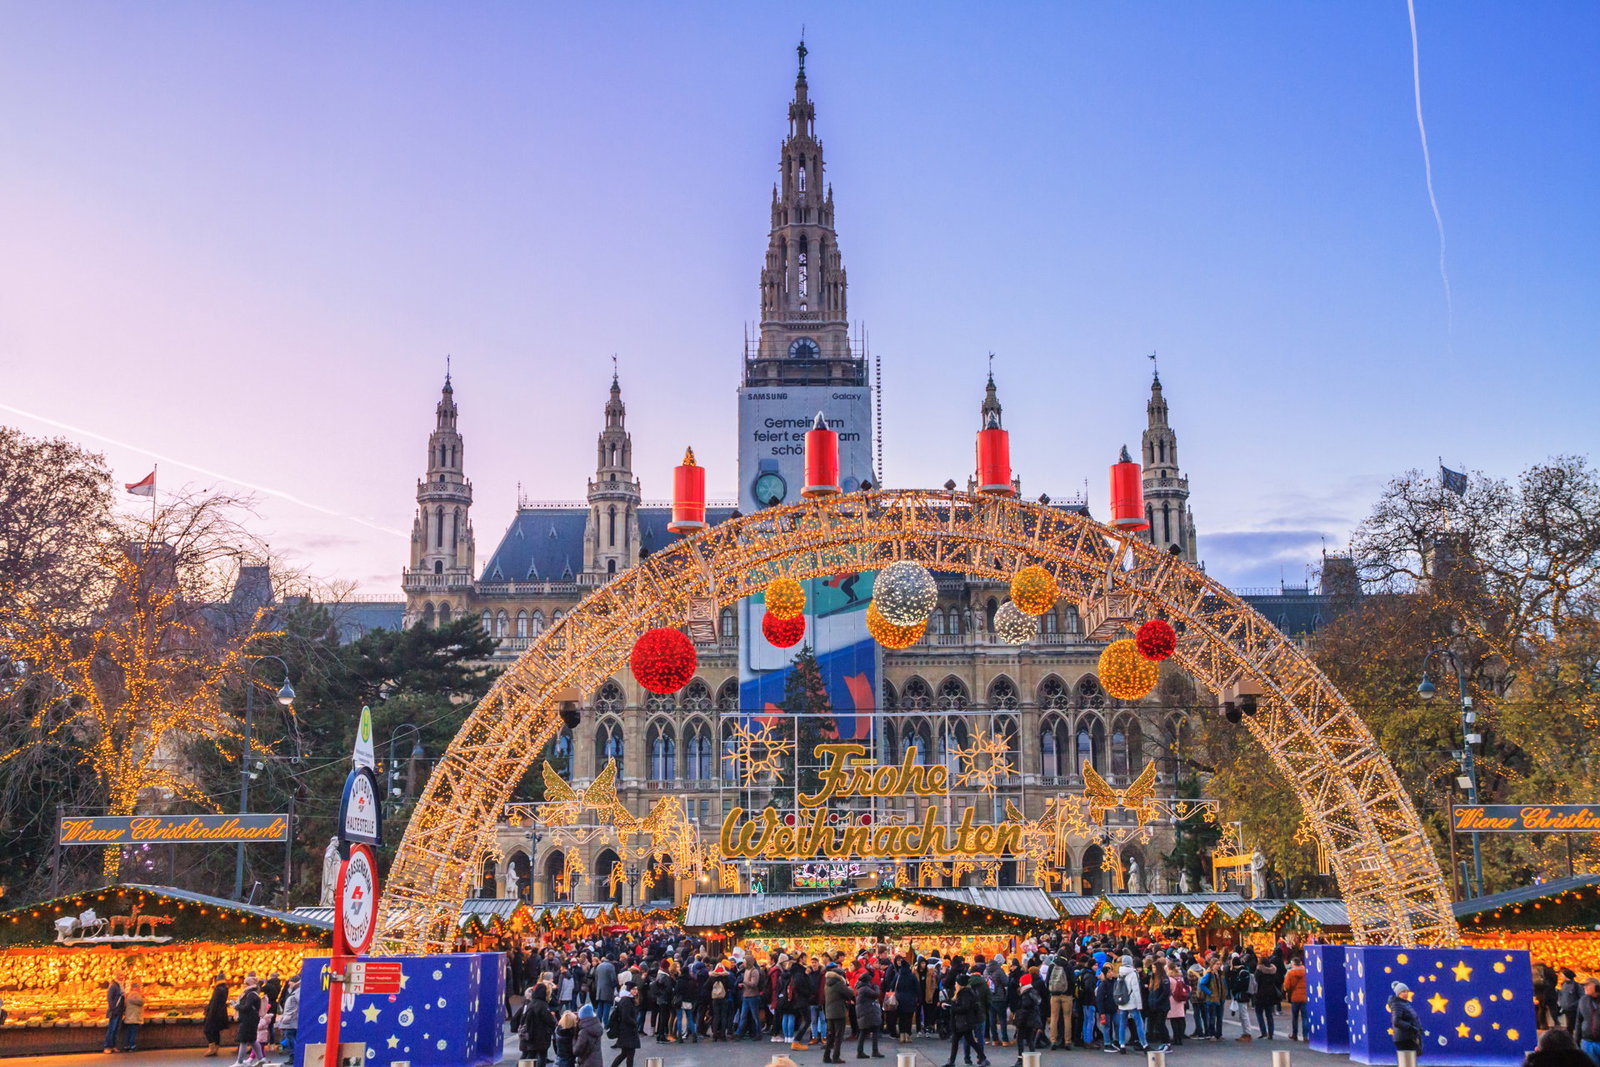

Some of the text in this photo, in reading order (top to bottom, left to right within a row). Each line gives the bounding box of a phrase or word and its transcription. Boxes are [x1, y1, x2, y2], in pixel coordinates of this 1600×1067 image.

[748, 393, 788, 401] SAMSUNG
[832, 393, 862, 401] Galaxy
[764, 416, 845, 428] Gemeinam
[754, 430, 788, 442] feiert
[798, 743, 949, 808] Frohe
[352, 778, 373, 806] AUTOBUS
[61, 817, 287, 841] Wiener Christkindlmarkt
[346, 816, 375, 835] HALTESTELLE
[1454, 807, 1518, 829] Wiener
[720, 805, 1025, 858] Weihnachten
[343, 858, 372, 895] STRASSENBAHN
[343, 911, 370, 942] HALTESTELLE
